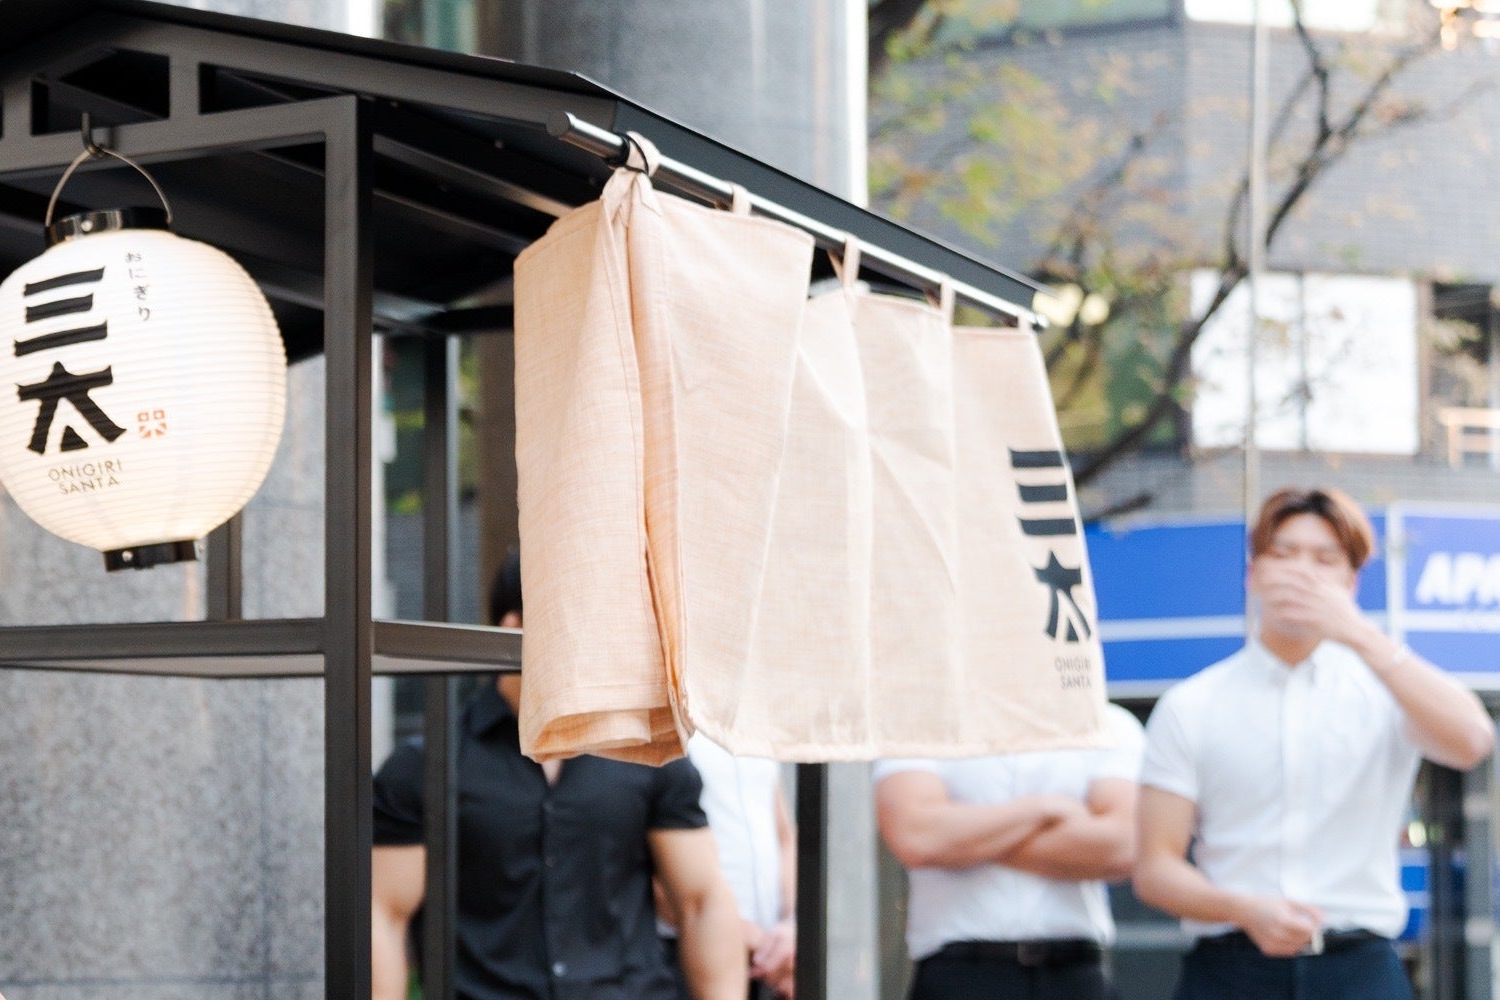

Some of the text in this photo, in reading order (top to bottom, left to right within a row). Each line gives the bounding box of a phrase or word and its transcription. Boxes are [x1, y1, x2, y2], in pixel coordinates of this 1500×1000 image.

[125, 251, 151, 322] おにぎり
[13, 265, 127, 456] 三太
[48, 458, 122, 482] ONIGIRI
[58, 475, 119, 495] SANTA
[1007, 446, 1092, 642] 三太
